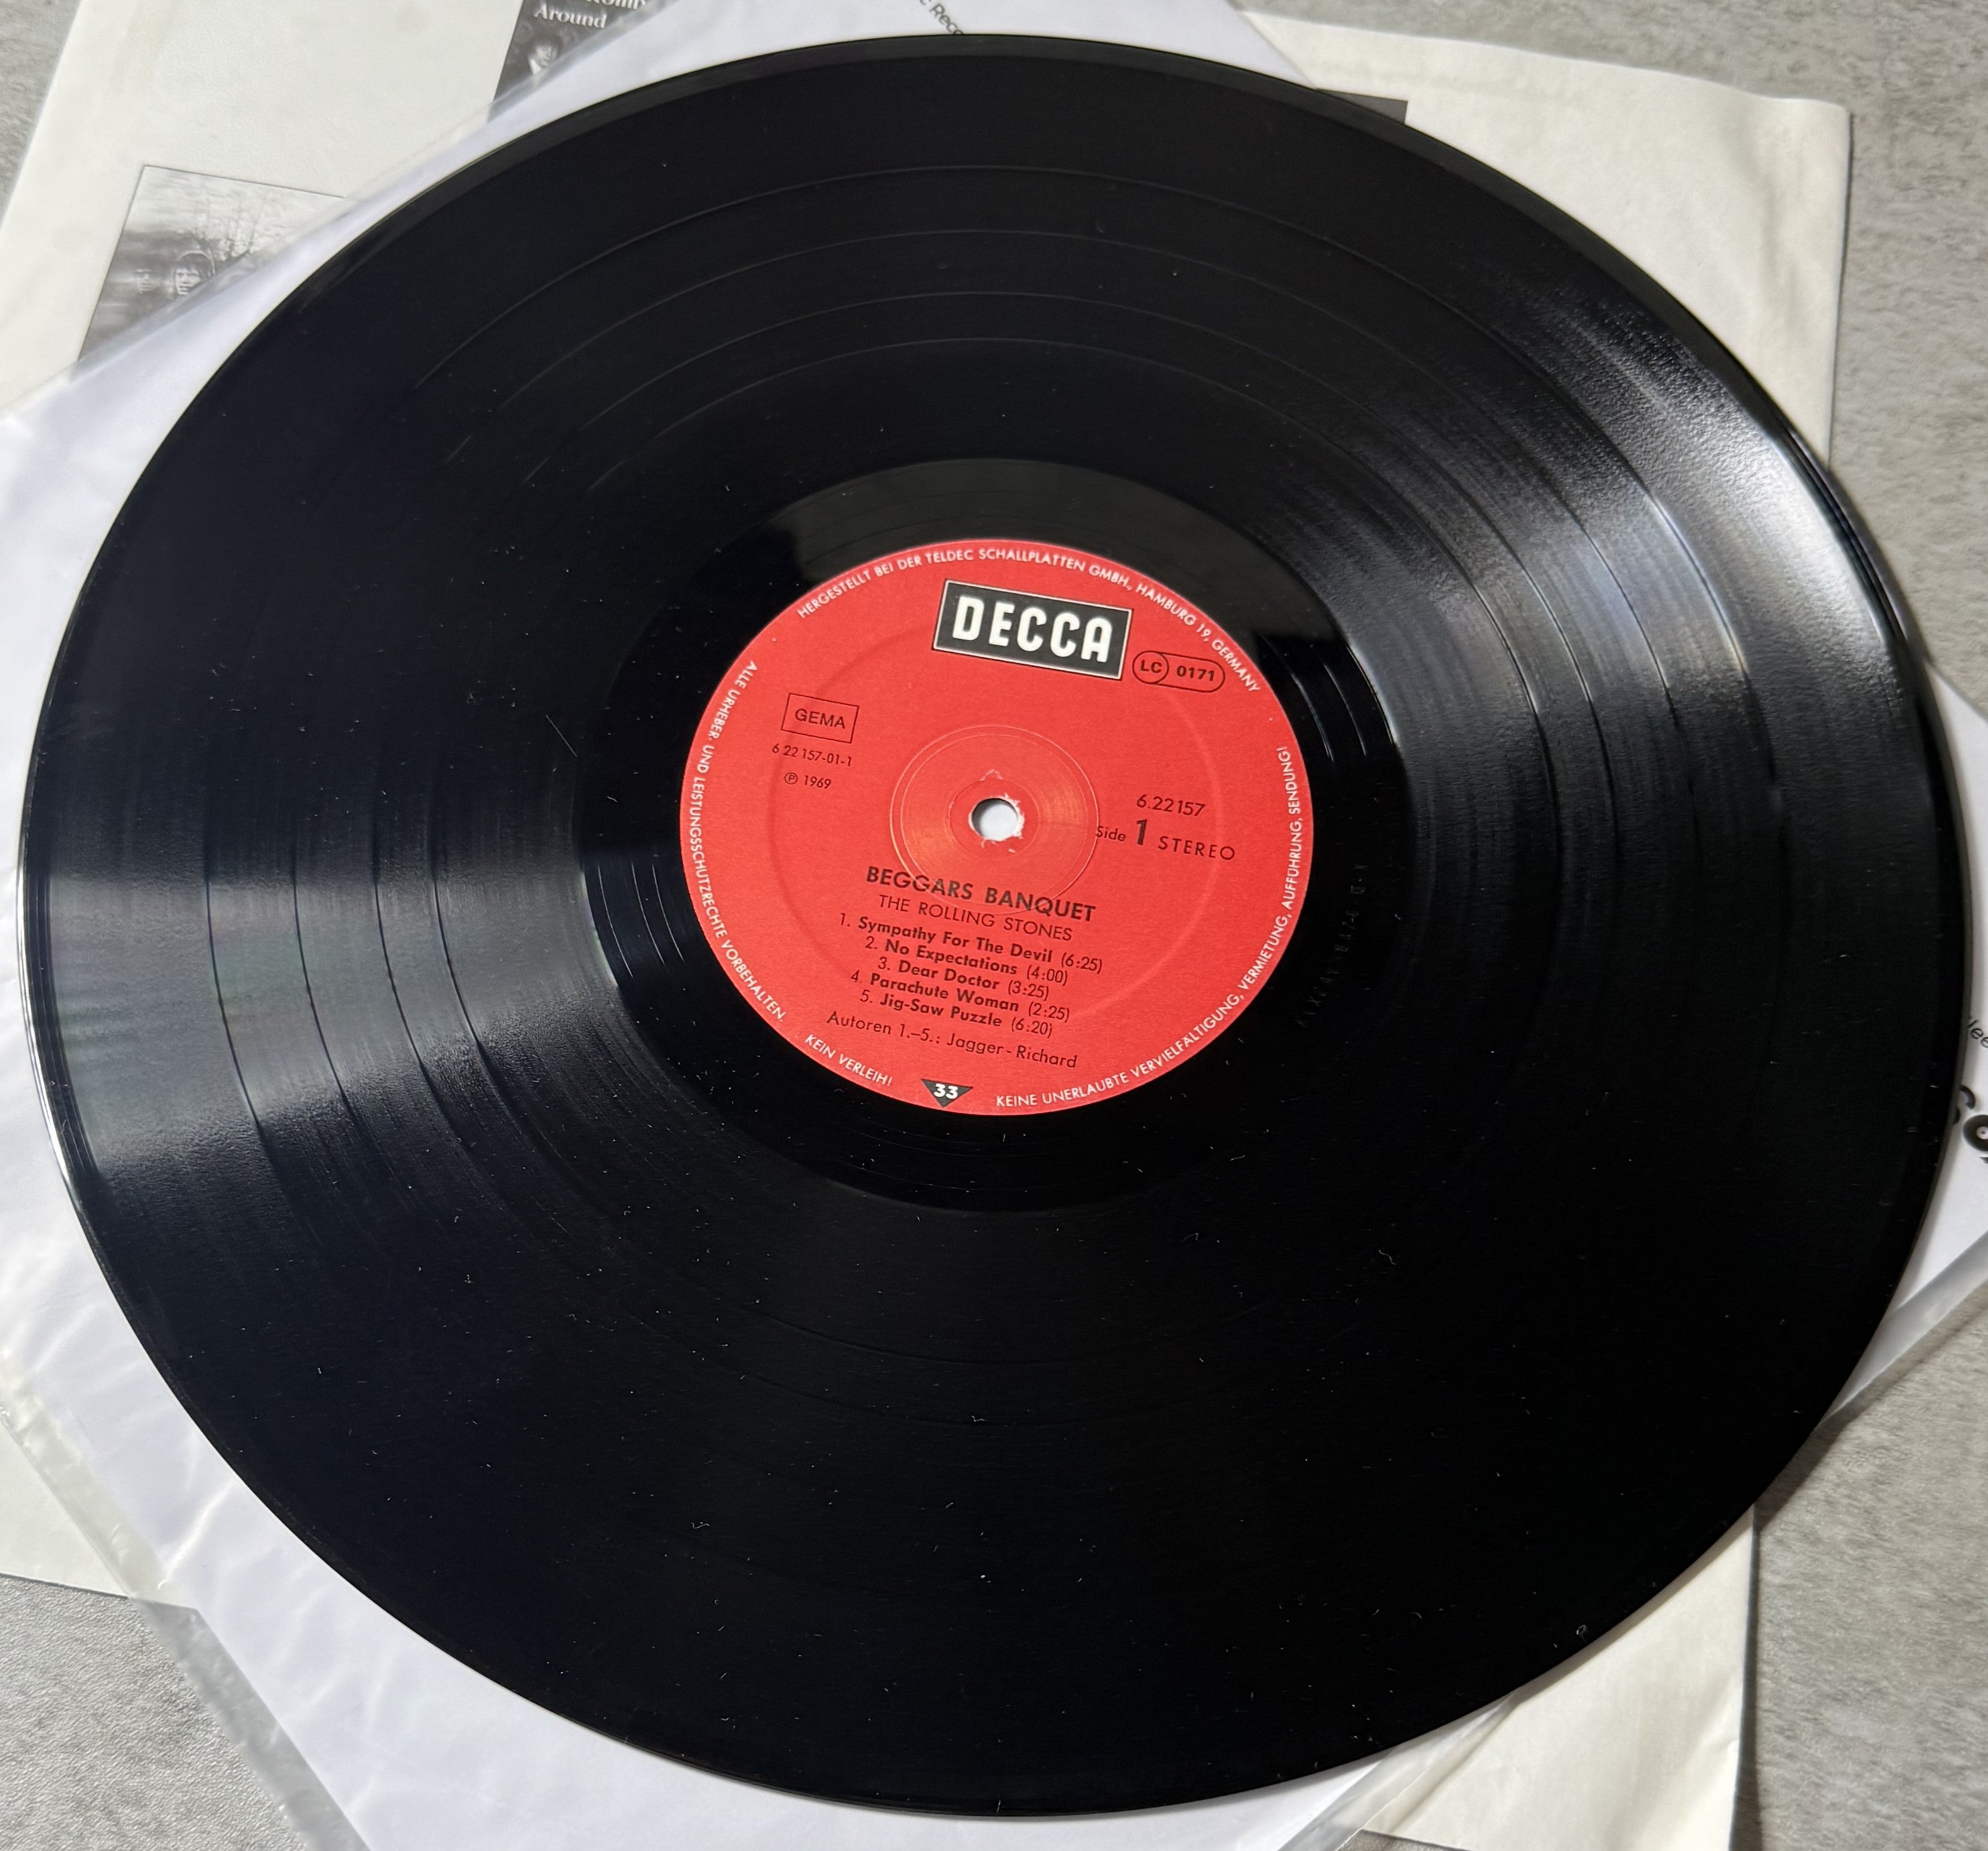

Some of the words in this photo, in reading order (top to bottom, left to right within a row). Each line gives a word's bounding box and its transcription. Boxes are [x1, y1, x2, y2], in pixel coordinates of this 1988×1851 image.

[533, 1, 607, 29] Around
[796, 570, 872, 619] HERGESTELLT
[875, 563, 895, 577] BEI
[898, 555, 921, 571] DER
[926, 550, 973, 564] TELDEC
[978, 549, 1085, 572] SCHALLPLATTEN
[1136, 583, 1196, 626] HAMBURG
[1196, 623, 1212, 641] 19,
[1211, 639, 1261, 692] GERMANY
[952, 595, 1113, 662] DECCA
[735, 660, 758, 689] ALLE
[1140, 660, 1162, 674] LC
[1176, 665, 1215, 682] 0171
[795, 708, 845, 729] GEMA
[697, 745, 715, 773] UND
[772, 743, 779, 754] 6
[804, 775, 831, 789] 1969
[689, 777, 727, 939] LEISTUNGSSCHUTZRECHTE
[1096, 825, 1126, 841] Side
[1136, 819, 1148, 845] 1
[1158, 836, 1235, 860] STEREO
[867, 866, 973, 900] BEGGARS
[985, 887, 1096, 921] BANQUET
[878, 894, 910, 912] THE
[918, 902, 995, 927] ROLLING
[1003, 917, 1073, 941] STONES
[996, 1094, 1037, 1108] KEINE
[1042, 1073, 1129, 1105] UNERLAUBTE
[1237, 914, 1293, 990] VERMIETUNG,
[1276, 746, 1301, 814] SENDUNG!
[840, 912, 850, 926] 1.
[858, 916, 936, 943] Sympathy
[942, 931, 969, 948] For
[976, 936, 1003, 954] The
[1010, 943, 1053, 963] Devil
[1061, 952, 1102, 974] (6:25)
[865, 936, 877, 949] 2.
[884, 939, 909, 955] No
[916, 945, 1017, 974] Expectations
[1027, 964, 1068, 986] (4:00)
[721, 940, 786, 1022] VORBEHALTEN.
[851, 970, 862, 983] 4.
[870, 973, 948, 998] Parachute
[957, 988, 1019, 1011] Woman
[1028, 1001, 1070, 1023] (2:25)
[878, 957, 890, 970] 3.
[898, 960, 938, 979] Dear
[944, 968, 1000, 989] Doctor
[1008, 979, 1049, 1001] (3:25)
[826, 1011, 892, 1035] Autoren
[860, 989, 872, 1003] 5.
[880, 993, 944, 1016] Jig-Saw
[951, 1006, 1002, 1026] Puzzle
[1012, 1017, 1052, 1038] (6:20)
[805, 1034, 836, 1059] KEIN
[839, 1054, 893, 1087] VERLEIH!
[933, 1083, 958, 1100] 33
